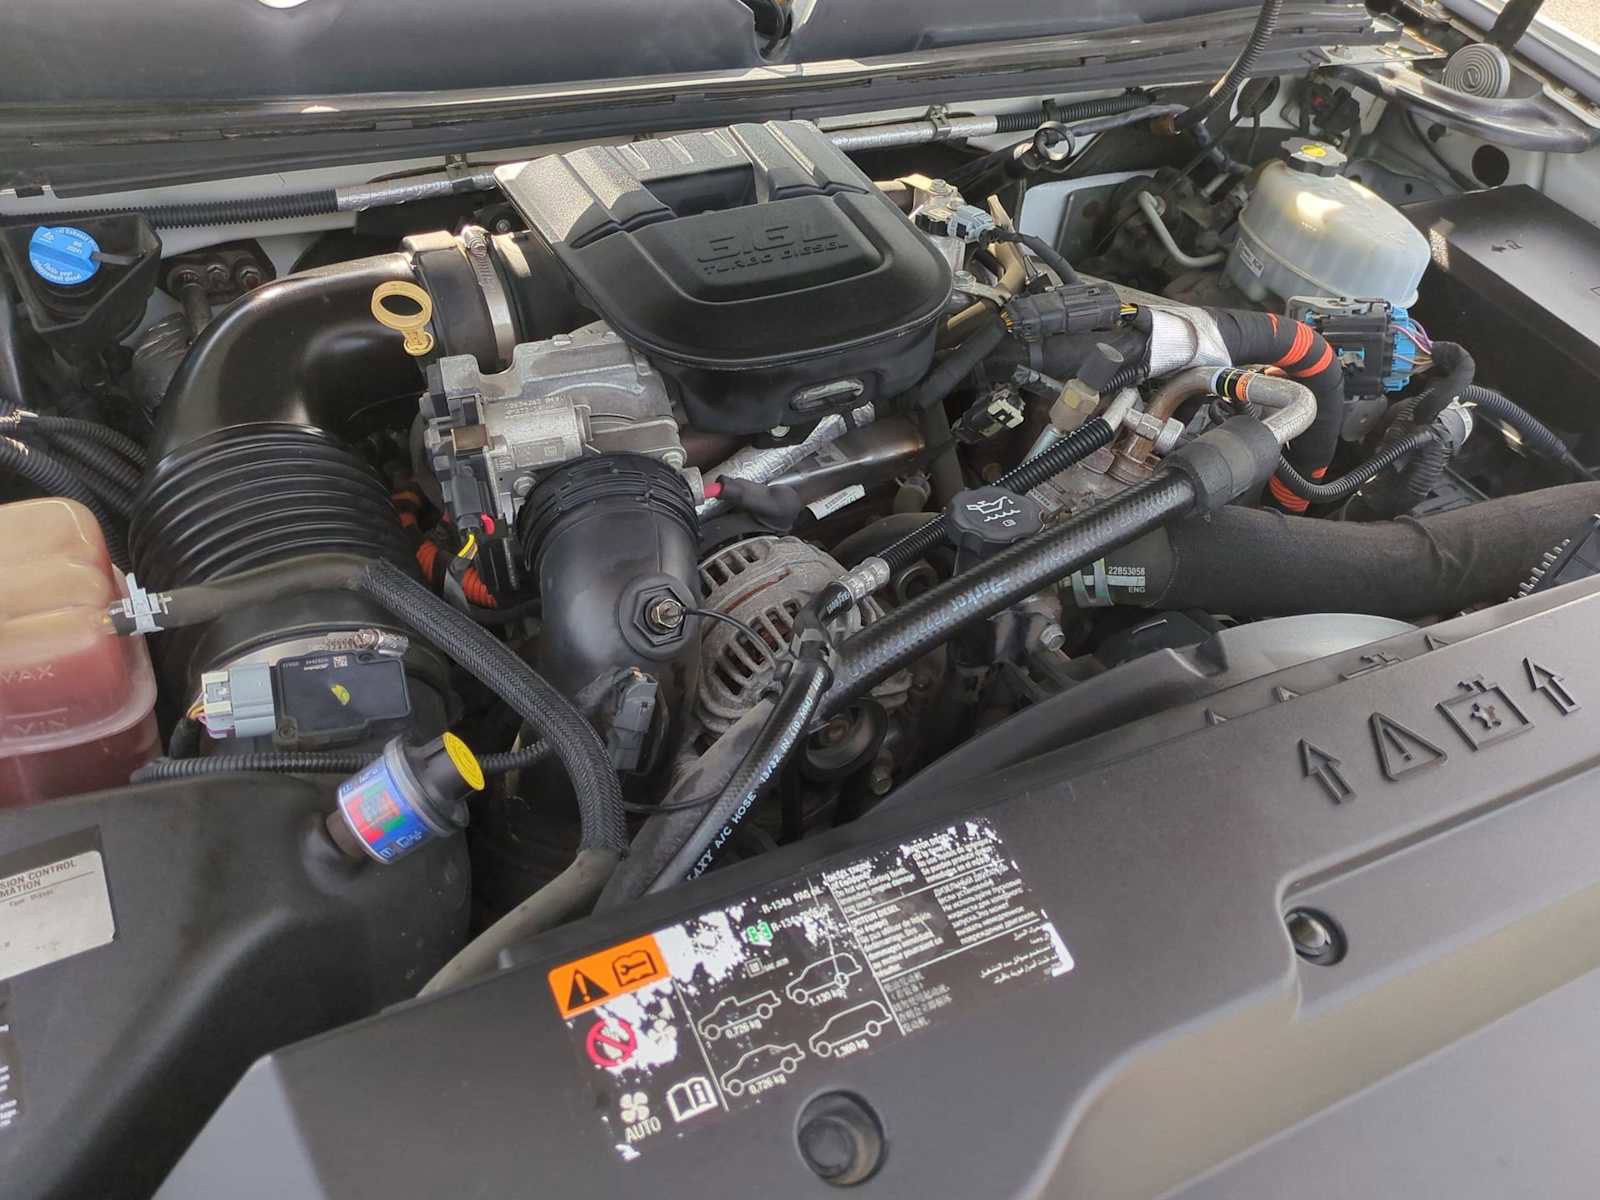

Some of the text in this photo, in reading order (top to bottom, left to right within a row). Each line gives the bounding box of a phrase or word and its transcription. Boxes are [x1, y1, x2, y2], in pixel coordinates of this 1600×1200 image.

[714, 827, 732, 849] A/C
[732, 791, 757, 824] HOSE
[28, 859, 77, 881] CONTROL
[748, 1019, 761, 1028] kg
[855, 1038, 868, 1048] kg
[771, 1073, 785, 1083] kg
[624, 1117, 661, 1142] AUTO
